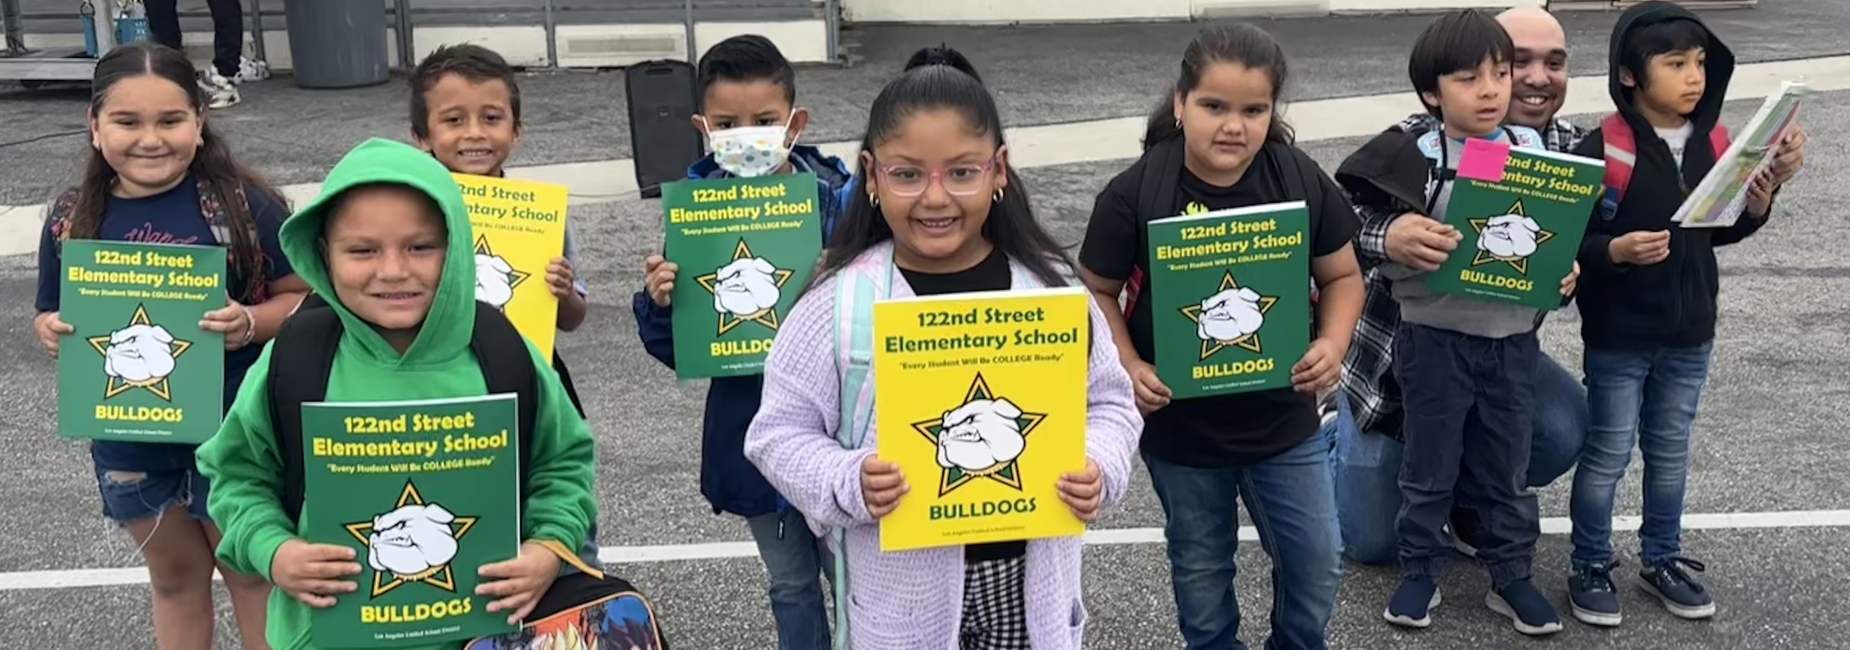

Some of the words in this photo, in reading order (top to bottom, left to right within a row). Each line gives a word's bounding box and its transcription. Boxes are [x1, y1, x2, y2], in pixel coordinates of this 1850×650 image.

[1504, 156, 1532, 170] 2nd
[1533, 160, 1576, 178] Street
[458, 184, 486, 196] 2nd
[492, 186, 536, 202] Street
[692, 186, 737, 202] 122nd
[741, 183, 786, 199] Street
[1531, 190, 1558, 200] COLLEGE
[1548, 177, 1594, 196] School
[511, 206, 558, 222] School
[670, 206, 760, 223] Elementary
[764, 199, 812, 216] School
[741, 224, 749, 232] Be
[750, 221, 780, 230] COLLEGE
[1180, 222, 1226, 240] 122nd
[1230, 218, 1277, 234] Street
[1157, 240, 1249, 260] Elementary
[1253, 231, 1302, 249] School
[94, 250, 142, 266] 122nd
[146, 251, 193, 268] Street
[1238, 253, 1267, 263] COLLEGE
[68, 267, 164, 288] Elementary
[168, 271, 219, 288] School
[1460, 269, 1534, 291] BULLDOGS
[142, 290, 151, 298] Be
[151, 291, 182, 299] COLLEGE
[917, 309, 977, 327] 122nd
[984, 307, 1045, 323] Street
[710, 338, 774, 357] BULLDO
[885, 333, 1007, 353] Elementary
[1014, 328, 1078, 346] School
[899, 362, 926, 370] "Every
[928, 359, 960, 368] Student
[962, 357, 978, 366] Will
[980, 357, 990, 365] Be
[992, 355, 1032, 364] COLLEGE
[1034, 353, 1064, 362] Ready"
[1192, 358, 1274, 379] BULLDOGS
[95, 405, 183, 422] BULLDOGS
[344, 414, 406, 433] 122nd
[412, 411, 474, 432] Street
[313, 437, 437, 458] Elementary
[444, 429, 507, 453] School
[327, 463, 354, 474] "Every
[356, 463, 389, 473] Student
[391, 462, 408, 472] Will
[410, 462, 421, 472] Be
[423, 459, 464, 470] COLLEGE
[465, 456, 495, 468] Ready"
[930, 497, 1036, 520] BULLDOGS
[361, 597, 472, 623] BULLDOGS
